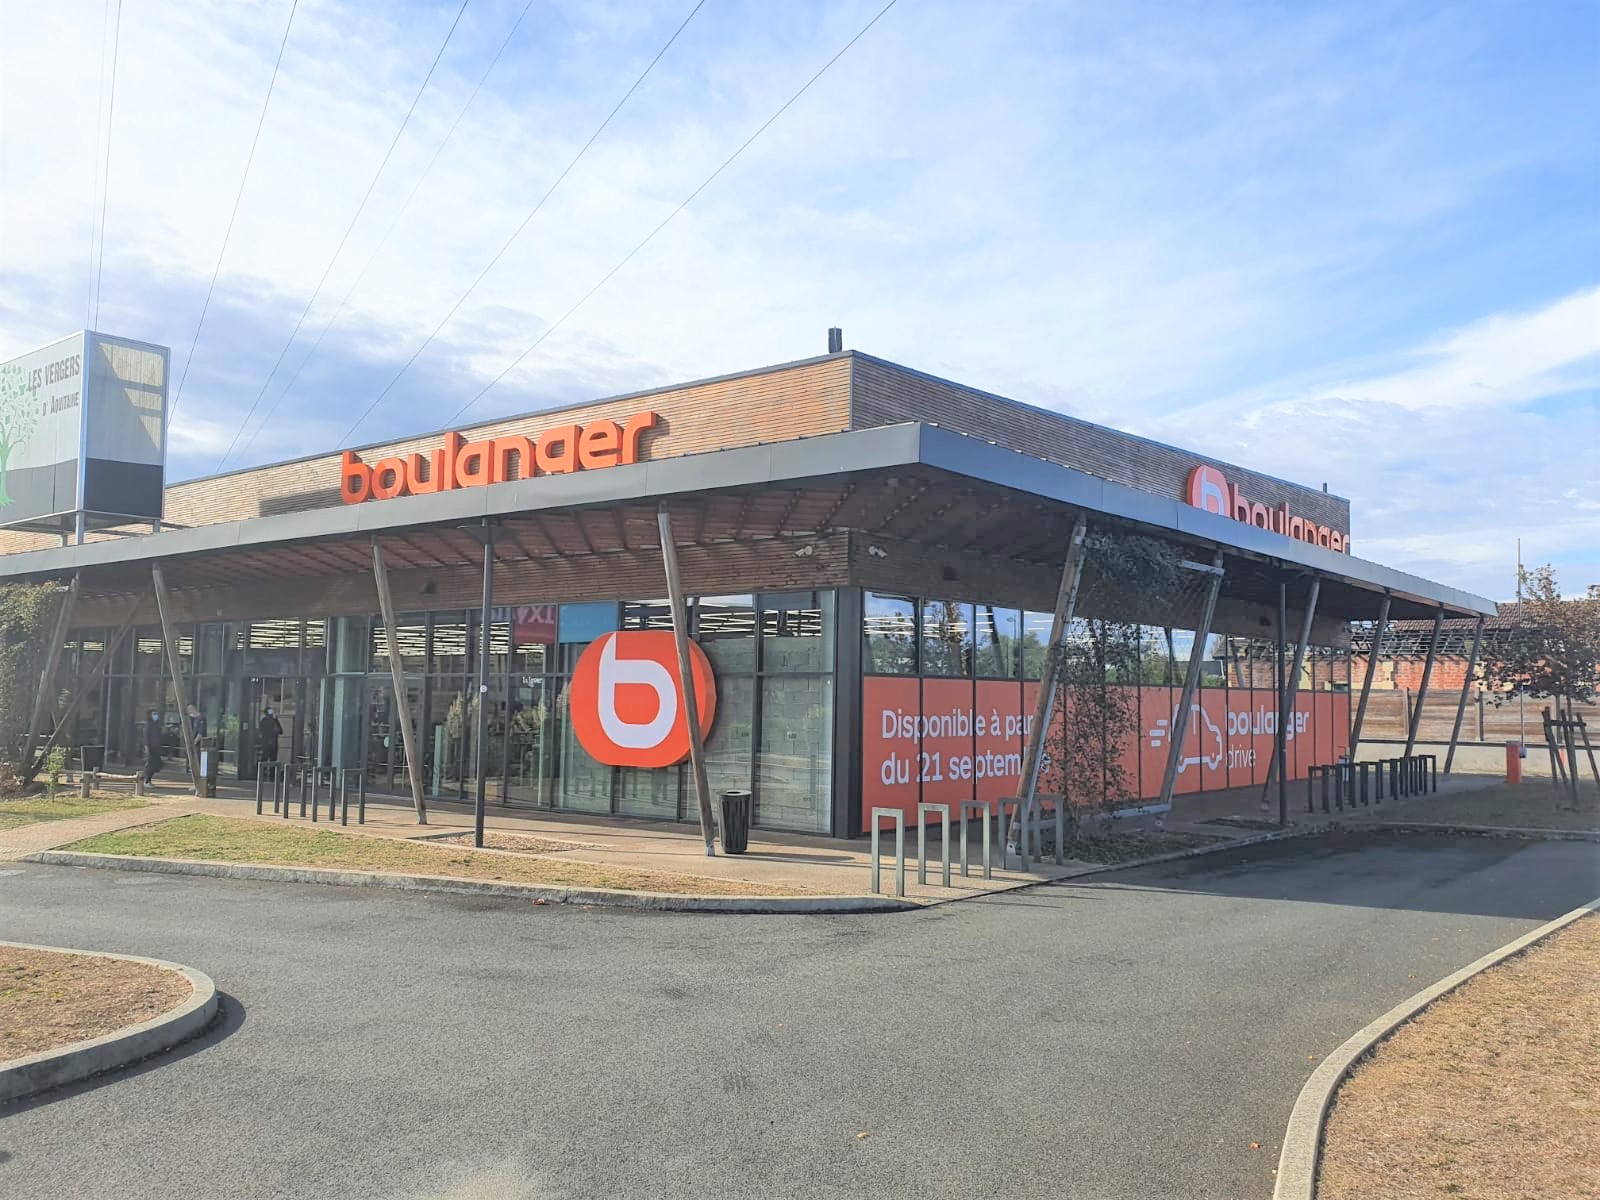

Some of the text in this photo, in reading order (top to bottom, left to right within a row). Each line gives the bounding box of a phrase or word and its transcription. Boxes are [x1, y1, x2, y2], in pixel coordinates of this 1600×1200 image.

[27, 354, 81, 392] LES VERGERS
[341, 411, 656, 504] boulanger
[1233, 482, 1350, 554] boulanger
[881, 707, 1037, 744] Disponible à par
[881, 752, 910, 785] du
[917, 751, 944, 783] 21
[1226, 743, 1257, 769] drive
